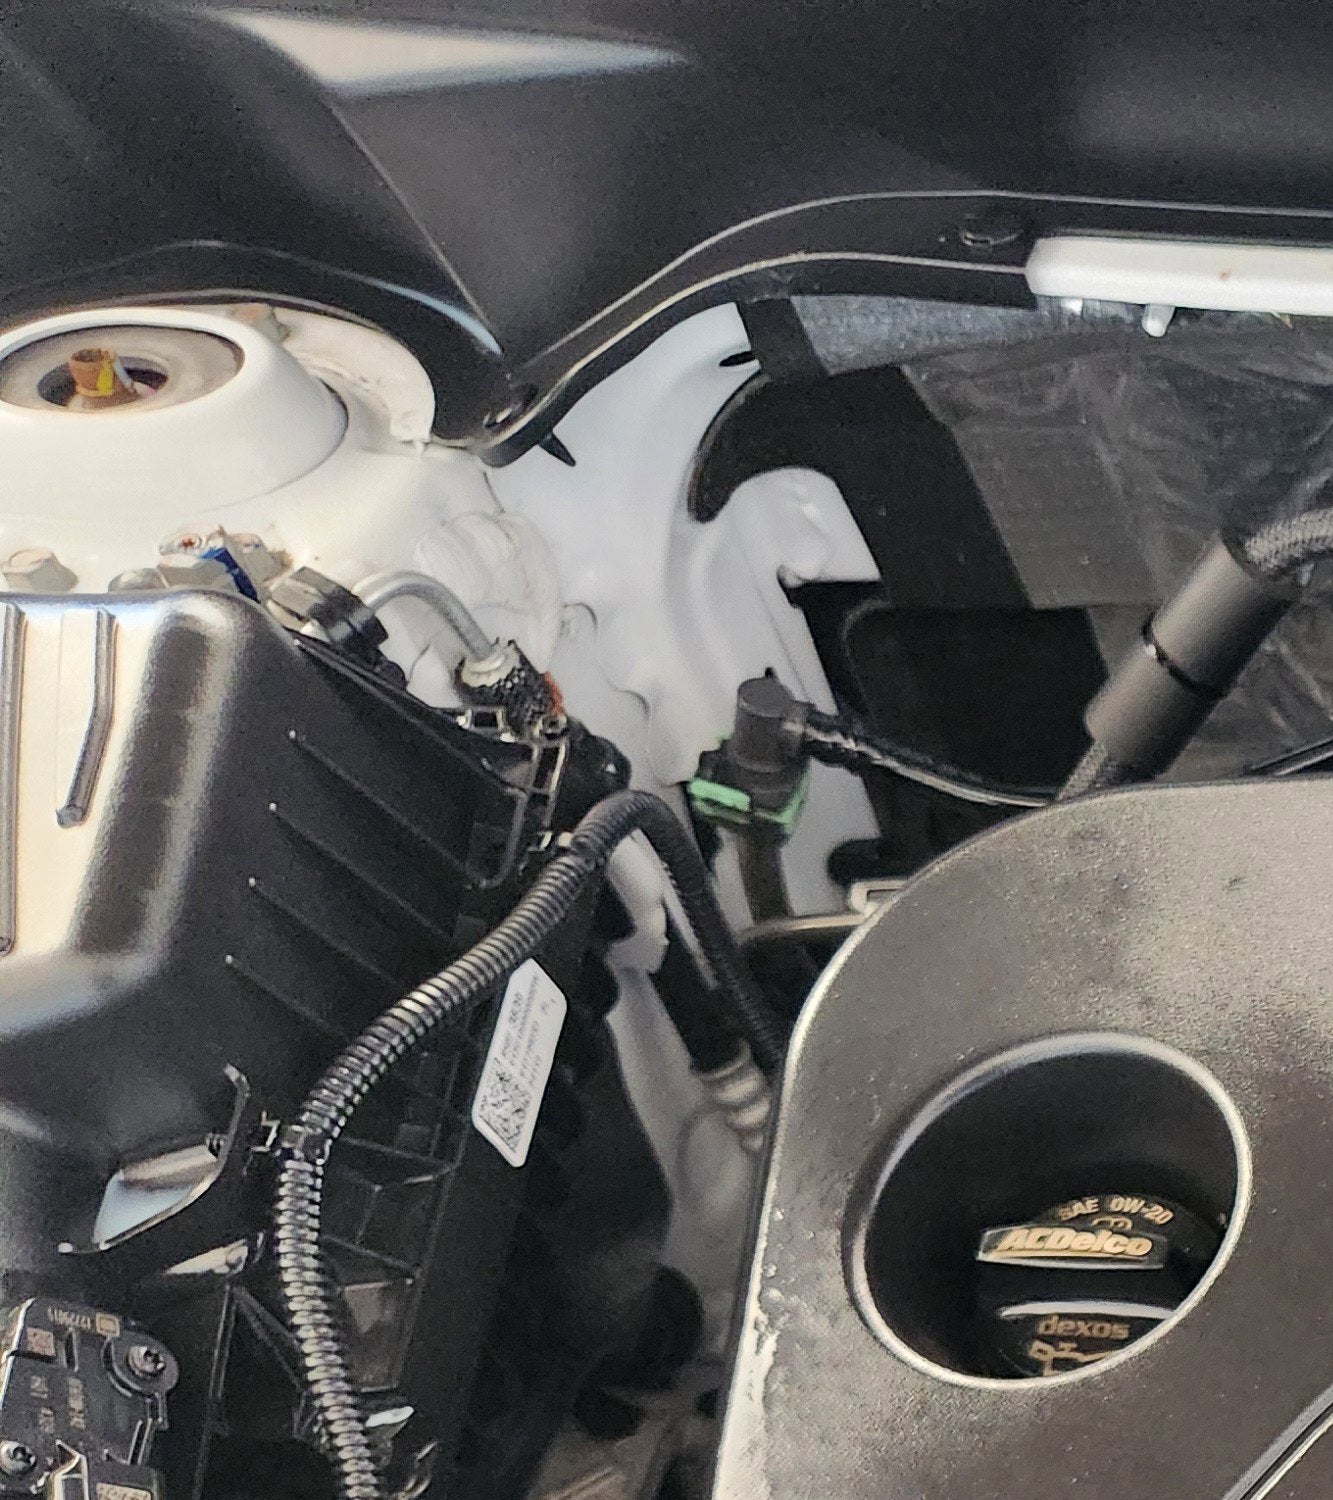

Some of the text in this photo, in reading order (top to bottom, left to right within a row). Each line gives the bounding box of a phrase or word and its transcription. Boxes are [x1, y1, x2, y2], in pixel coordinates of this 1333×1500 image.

[1058, 1197, 1174, 1225] SAE 0W-20
[996, 1227, 1152, 1256] ACDelco
[1038, 1316, 1129, 1339] dexos
